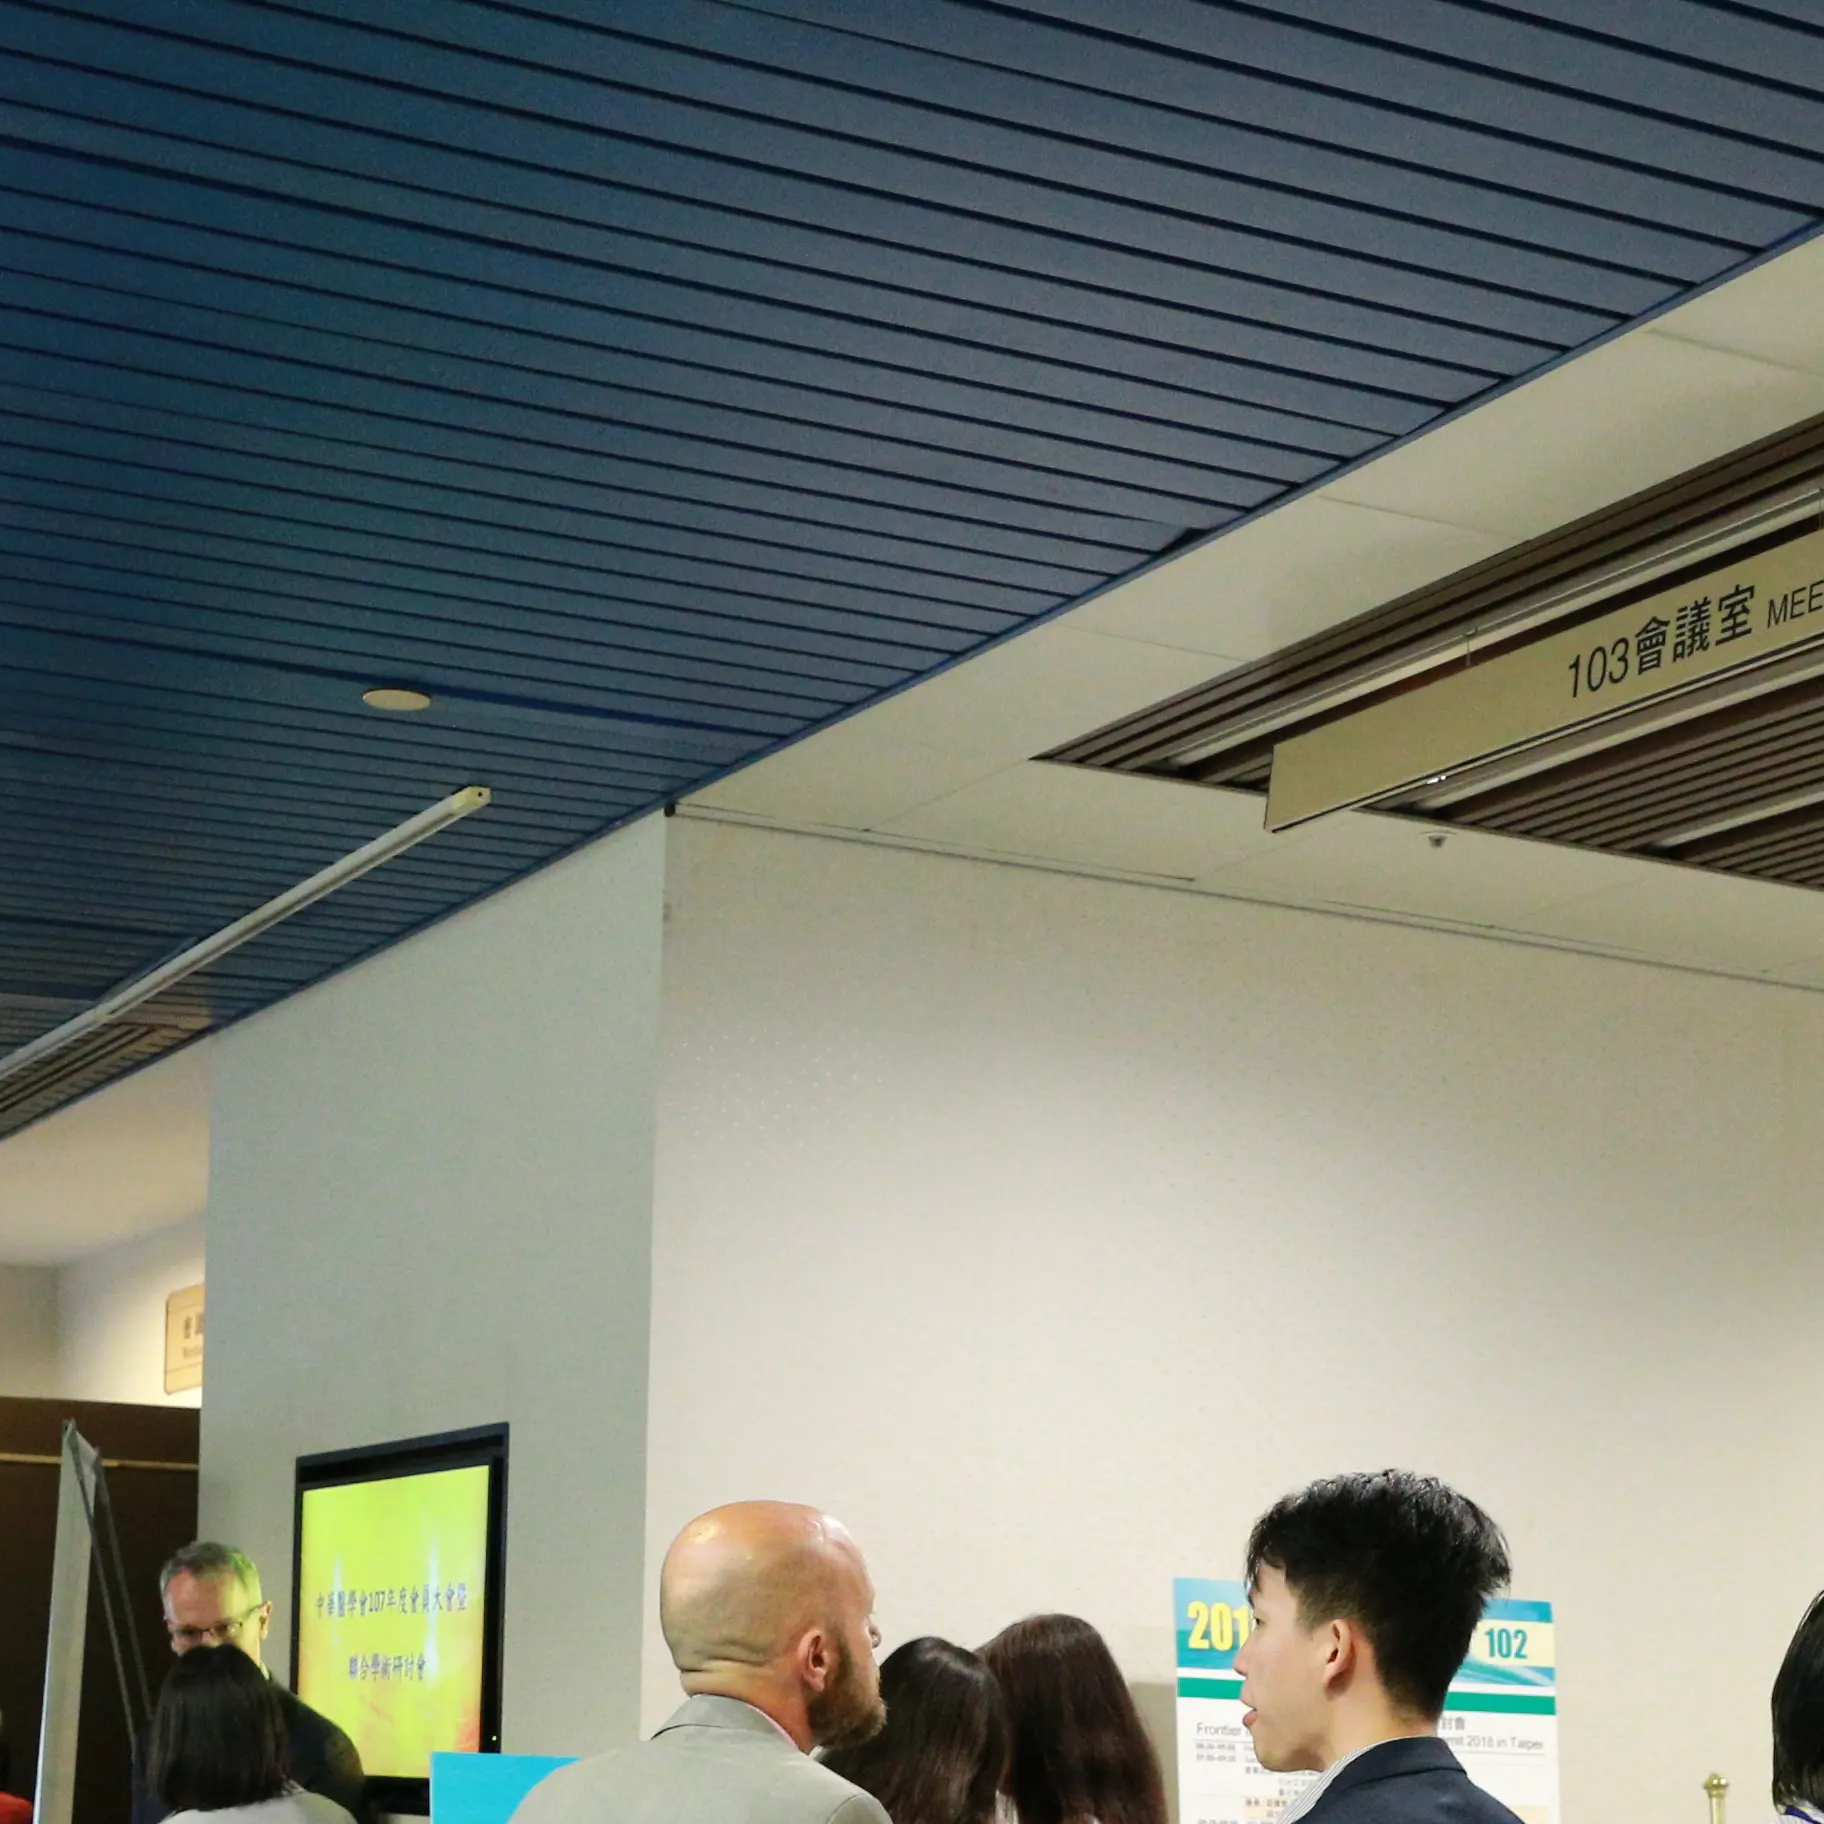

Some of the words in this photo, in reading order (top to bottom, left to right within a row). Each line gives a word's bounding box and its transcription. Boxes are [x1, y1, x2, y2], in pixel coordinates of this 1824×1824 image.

[1568, 584, 1756, 698] 103會議室
[1187, 1600, 1249, 1652] 201
[1485, 1627, 1528, 1660] 102
[1196, 1721, 1242, 1737] Frontier
[1466, 1735, 1494, 1748] 2018
[1510, 1736, 1544, 1751] Taipei
